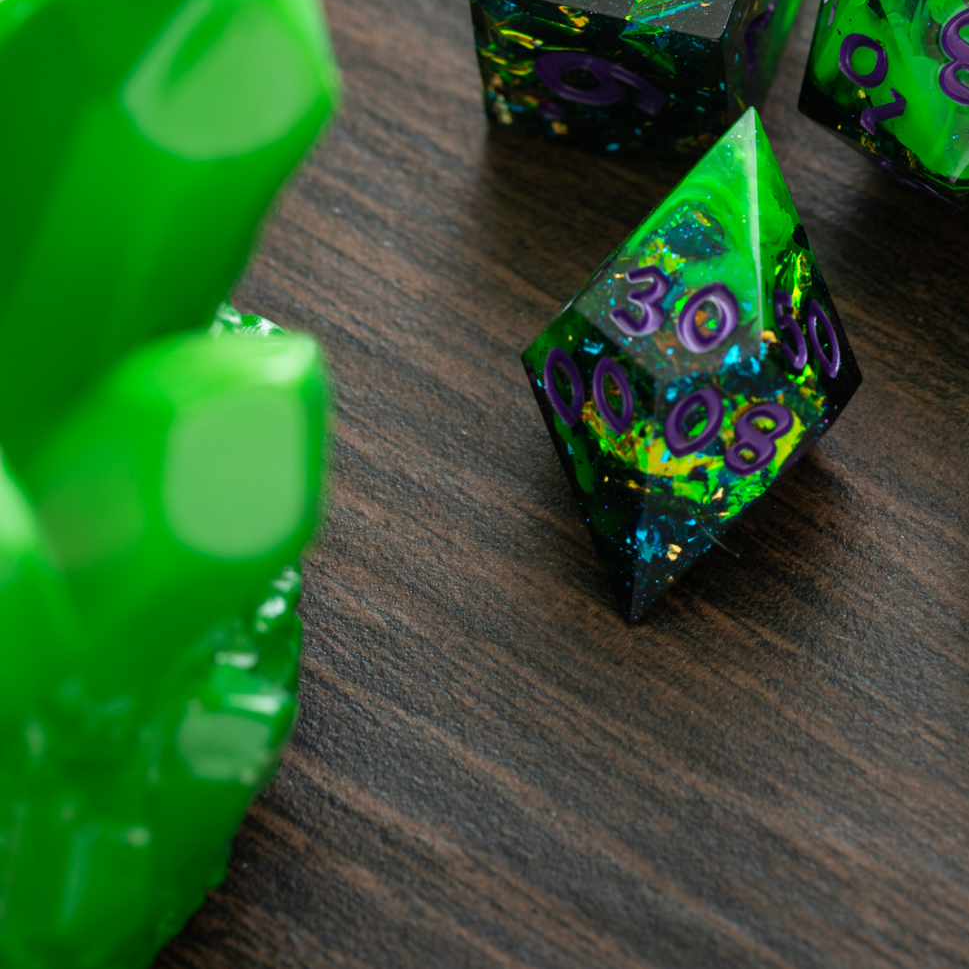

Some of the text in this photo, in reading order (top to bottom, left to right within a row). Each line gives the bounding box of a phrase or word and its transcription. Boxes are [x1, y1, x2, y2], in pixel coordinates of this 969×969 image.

[838, 32, 906, 136] 10
[608, 264, 741, 355] 30
[773, 289, 840, 379] 50
[543, 345, 634, 435] 00
